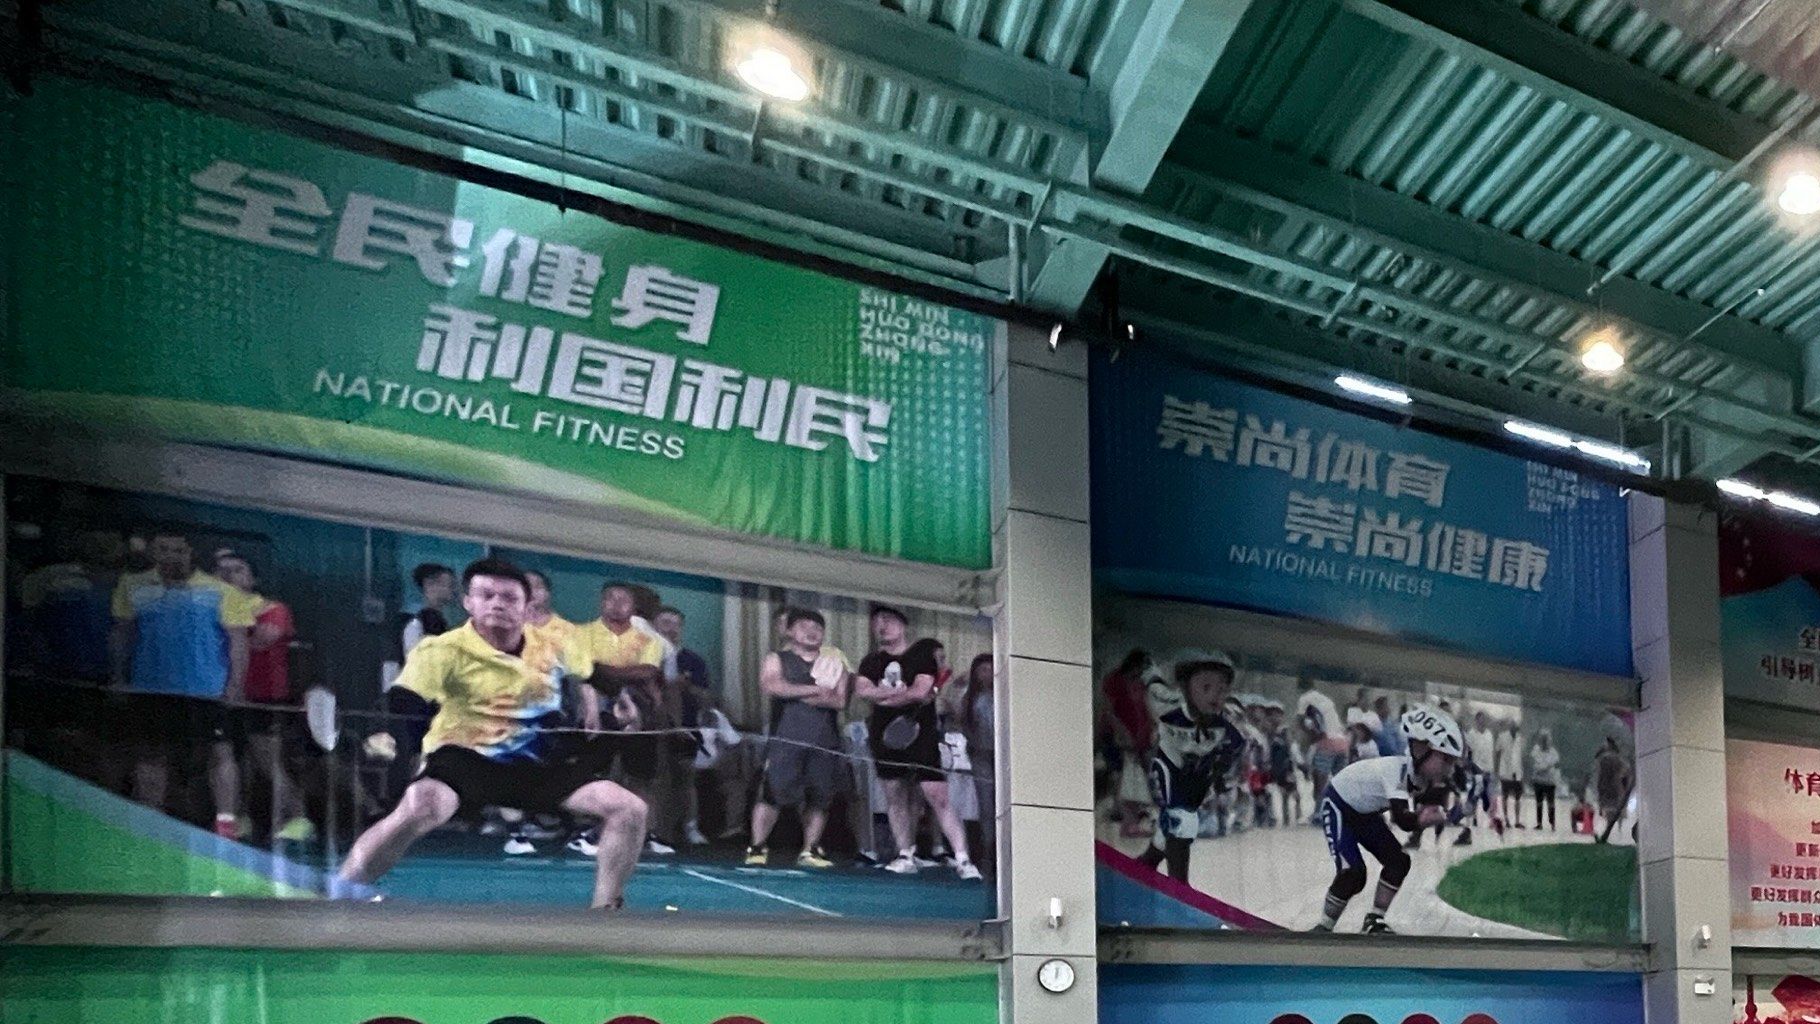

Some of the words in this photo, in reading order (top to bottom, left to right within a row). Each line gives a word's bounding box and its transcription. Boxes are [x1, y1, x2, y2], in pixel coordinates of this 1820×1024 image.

[178, 160, 721, 346] 全民健身
[313, 367, 520, 432] NATIONAL
[532, 408, 687, 459] FITNESS
[417, 304, 891, 462] 利国利民
[1156, 395, 1451, 508] 崇尚体育
[1228, 544, 1339, 584] NATIONAL
[1345, 566, 1432, 598] FITNESS
[1285, 490, 1550, 592] 崇尚健康
[1414, 711, 1446, 736] 067
